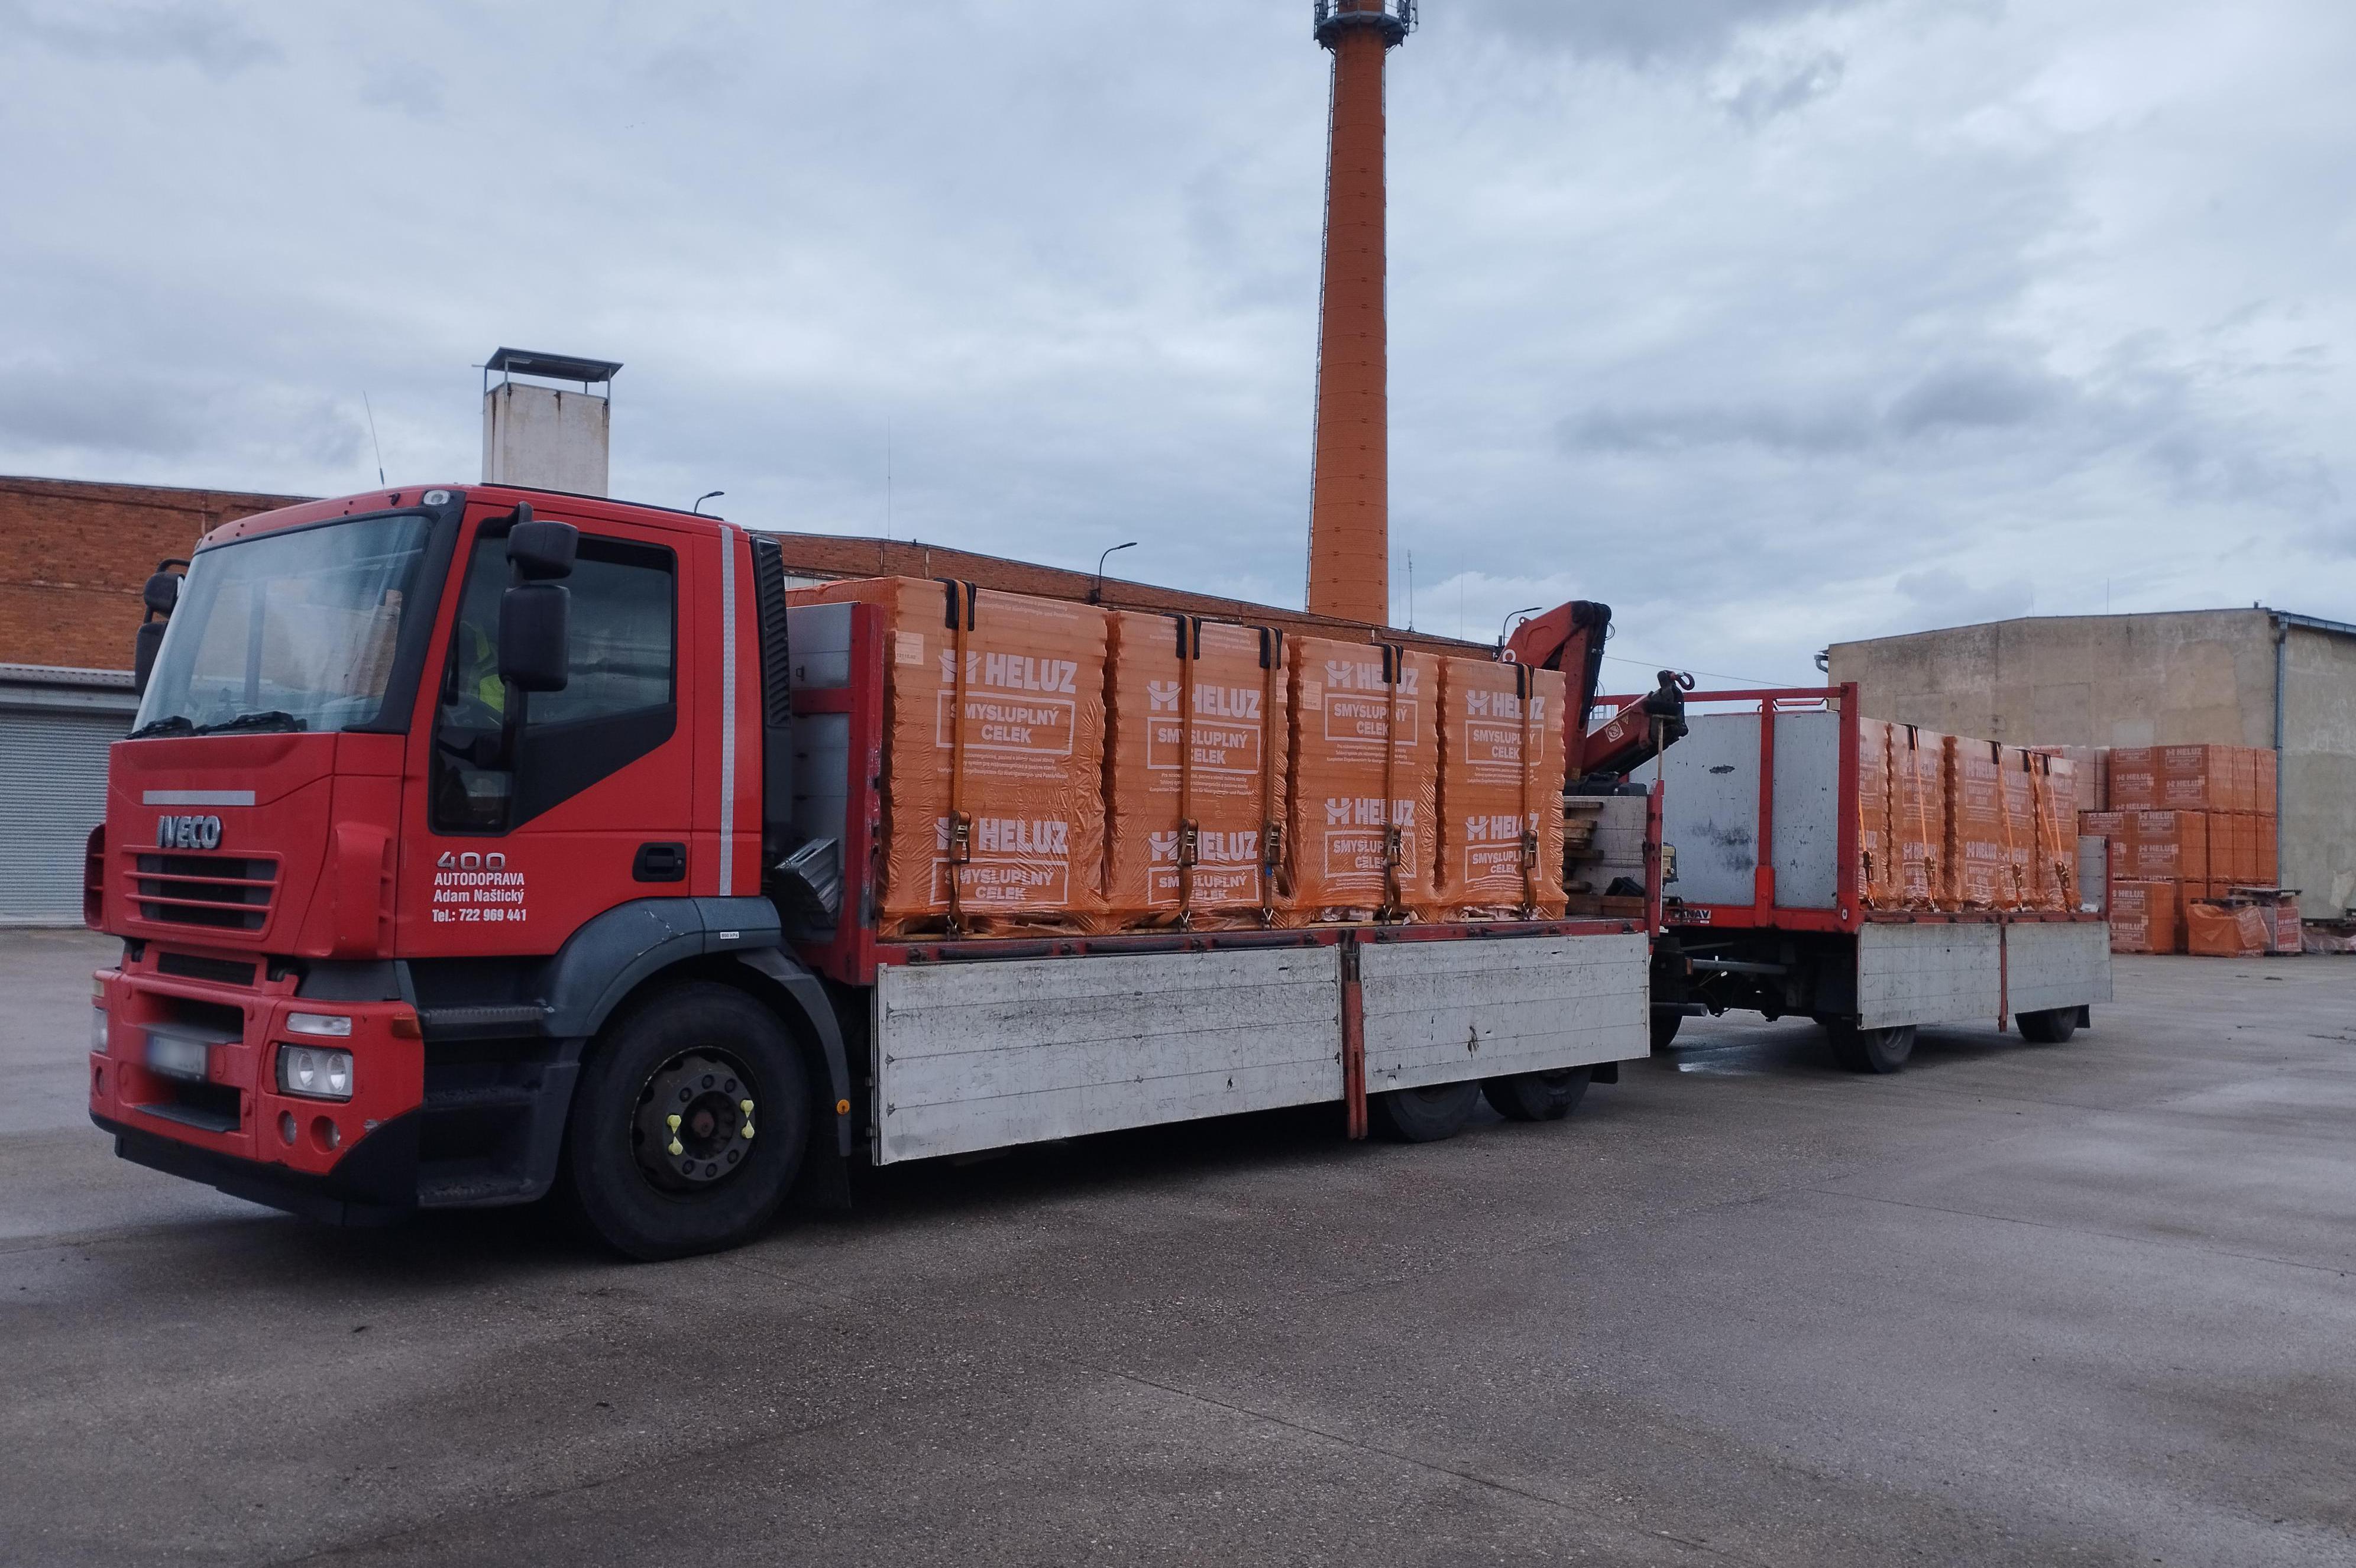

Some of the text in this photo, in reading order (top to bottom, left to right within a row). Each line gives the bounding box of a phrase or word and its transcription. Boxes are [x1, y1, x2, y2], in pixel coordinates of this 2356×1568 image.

[985, 652, 1077, 694] HELUZ
[981, 724, 1032, 743] CELEK
[1473, 729, 1536, 745] SMYSLUPLÝ
[1191, 748, 1226, 764] ELEK
[1491, 745, 1520, 760] CELEK
[156, 815, 221, 849] IVECO
[979, 818, 1068, 854] HELUZ
[1334, 840, 1384, 853] SMYSLUP
[437, 851, 506, 871] 400
[1472, 850, 1523, 864] SMYSLUPLN
[1490, 864, 1517, 874] CELEK
[434, 872, 525, 886] AUTODOPRAVA
[433, 888, 525, 905] Adam Naštický
[432, 908, 526, 922] Tel.: 722 969 441
